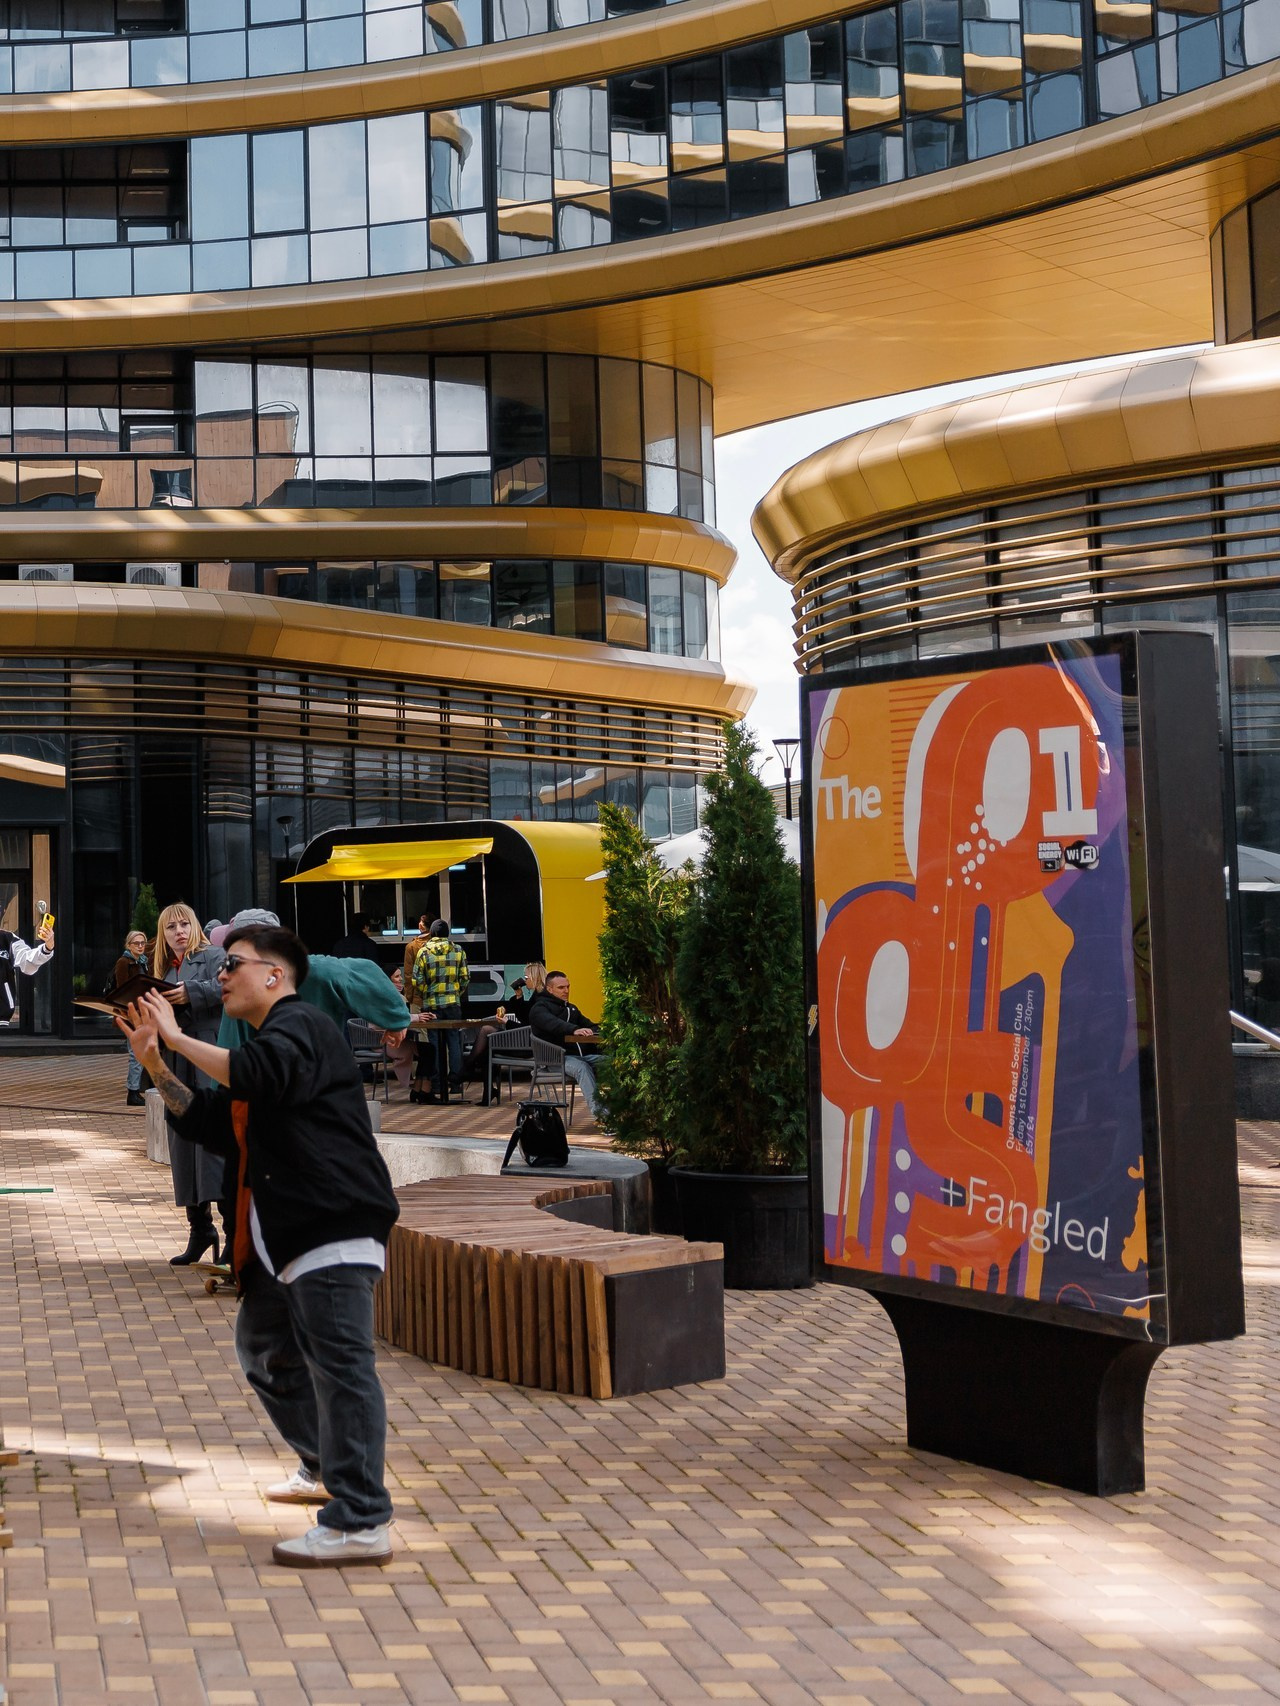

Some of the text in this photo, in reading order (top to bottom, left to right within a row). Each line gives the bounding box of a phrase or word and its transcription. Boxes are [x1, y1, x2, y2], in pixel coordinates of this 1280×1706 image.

[818, 774, 883, 820] The
[1006, 1003, 1024, 1150] Queens Road Social Club
[1015, 989, 1035, 1153] Friday 1st December 7.30pm
[1026, 1115, 1035, 1131] £4
[1025, 1140, 1033, 1156] £5
